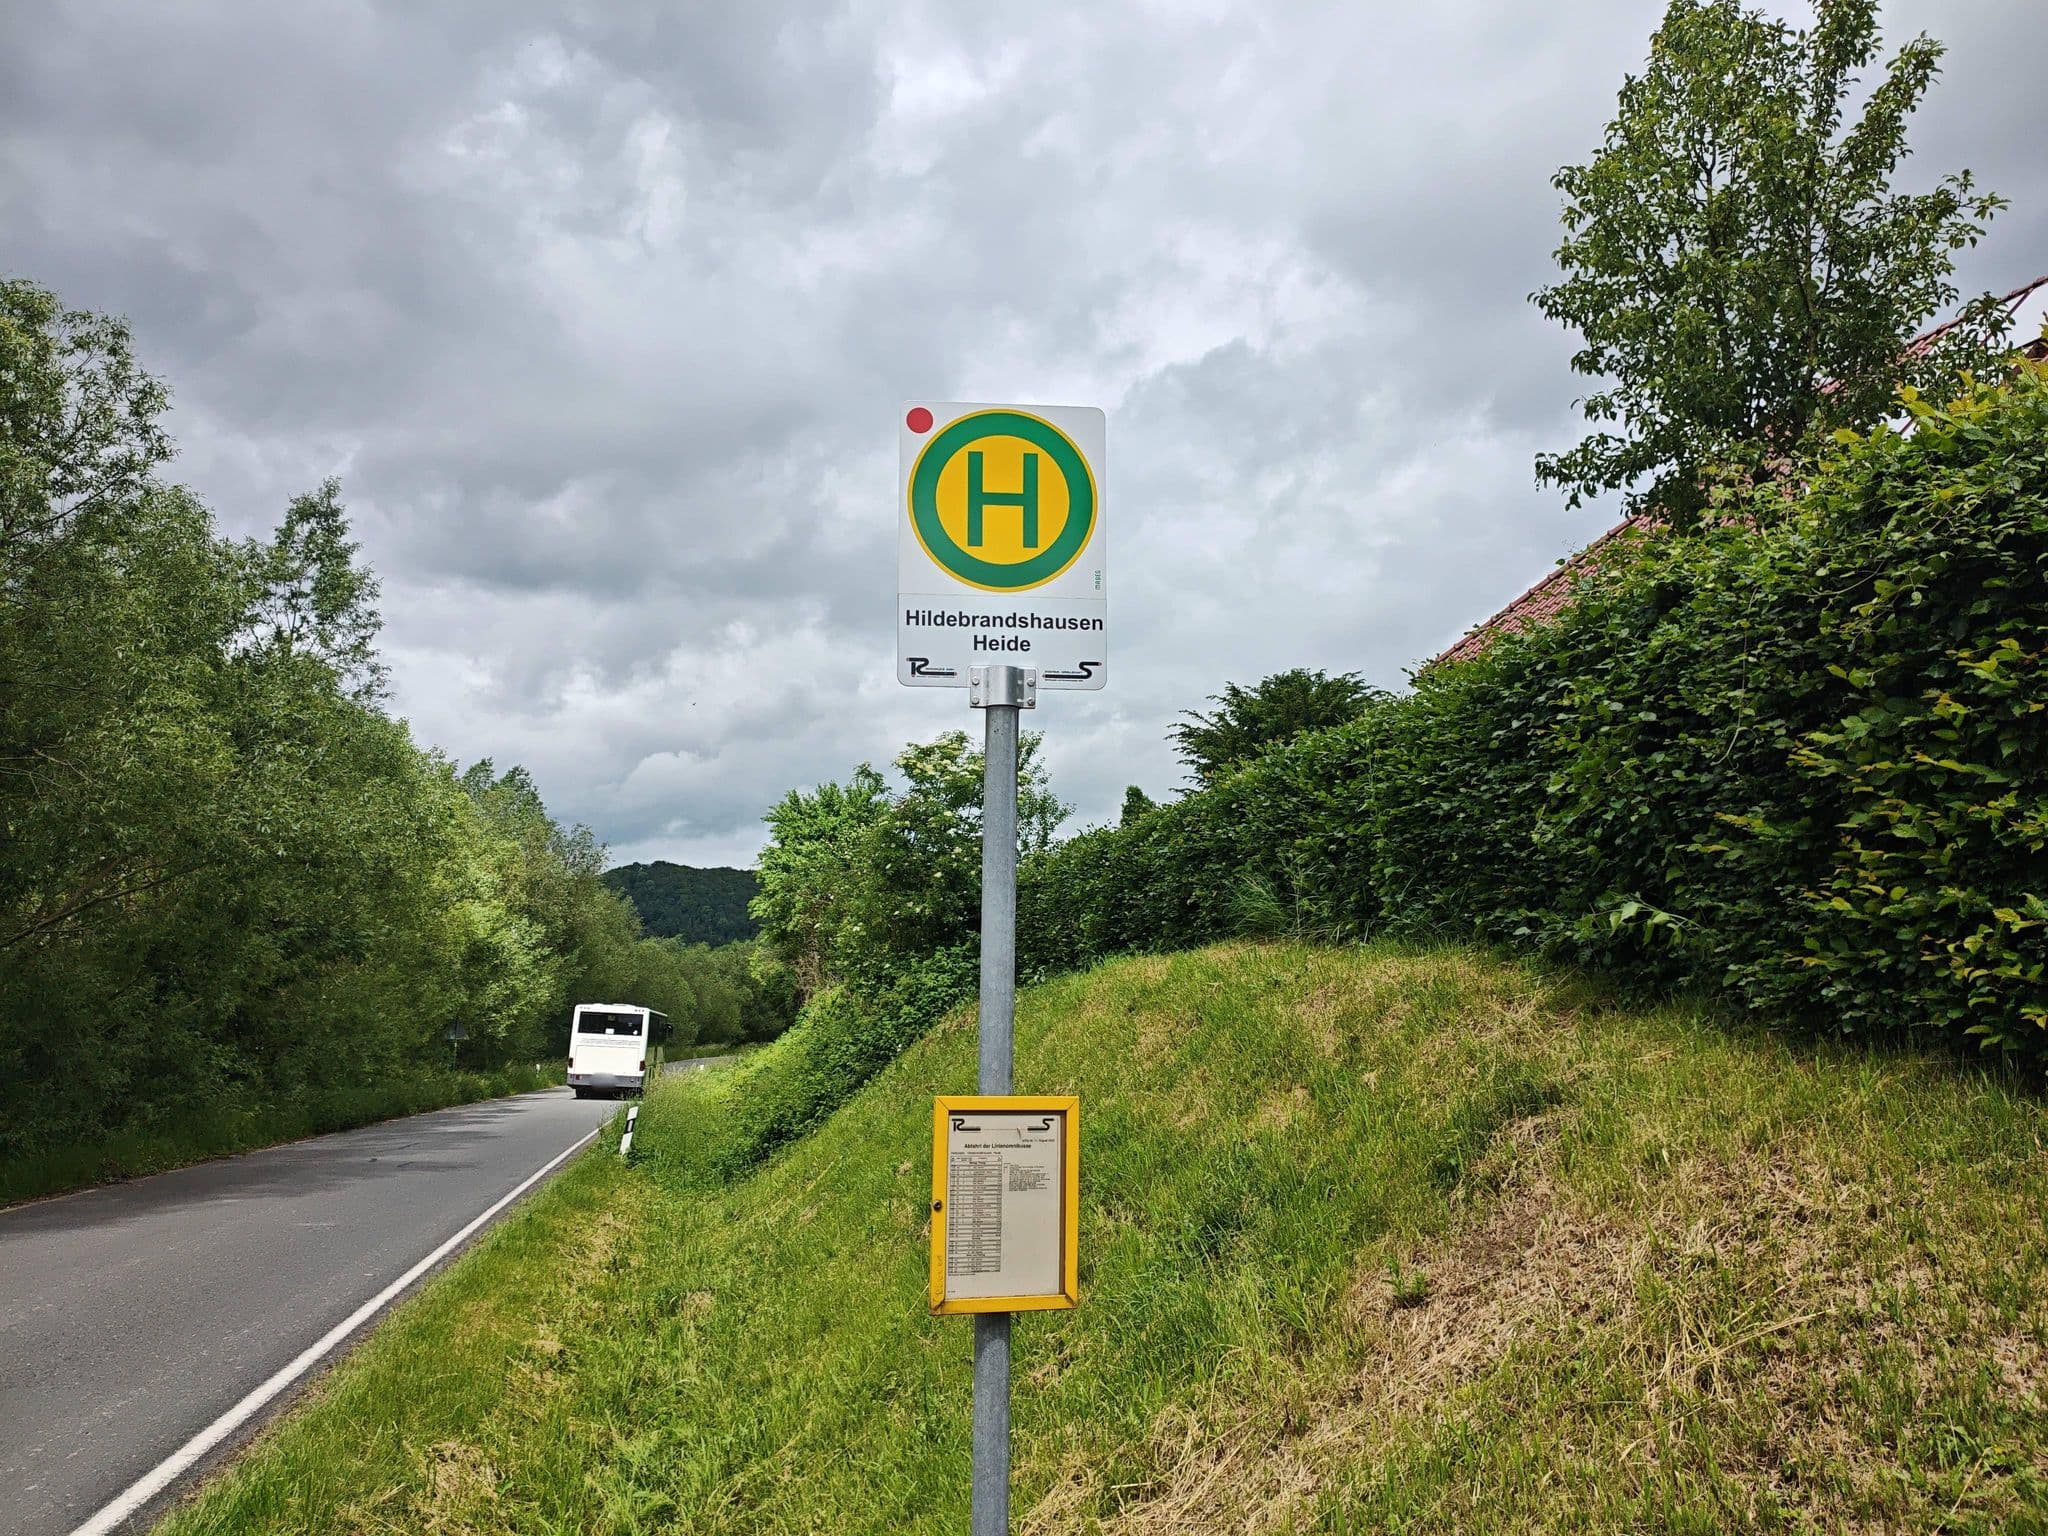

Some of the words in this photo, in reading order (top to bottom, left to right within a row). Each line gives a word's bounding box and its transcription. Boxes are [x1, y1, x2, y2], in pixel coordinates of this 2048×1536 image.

[967, 451, 1038, 548] H
[906, 610, 1103, 630] Hildebrandshausen
[973, 635, 1031, 651] Heide
